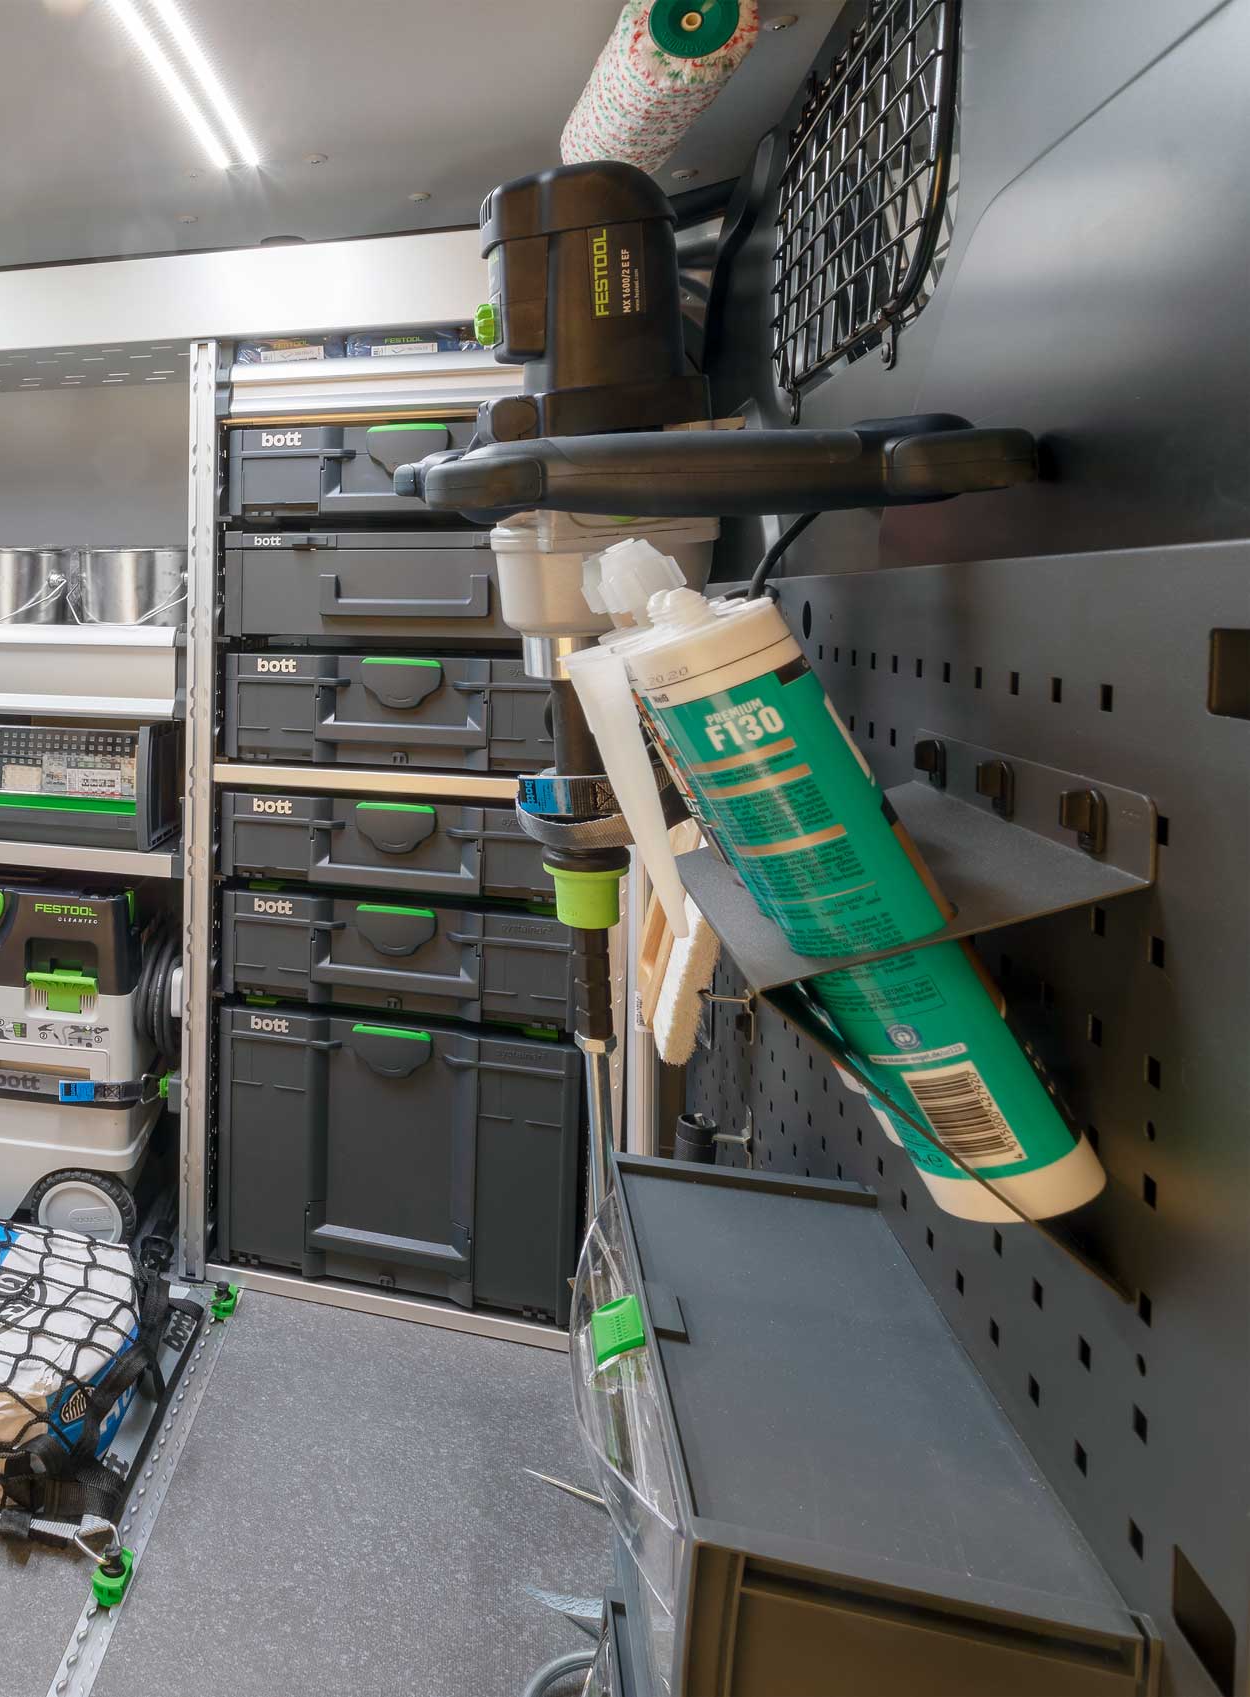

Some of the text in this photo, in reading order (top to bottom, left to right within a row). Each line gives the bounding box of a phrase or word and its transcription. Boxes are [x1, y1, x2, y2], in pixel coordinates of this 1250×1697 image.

[621, 249, 630, 260] EF
[593, 229, 609, 317] FESTOOL
[621, 268, 630, 299] 1600/2
[622, 300, 631, 313] MX
[384, 335, 423, 344] FESTOOL
[261, 432, 302, 447] bott
[254, 536, 282, 546] bott
[257, 658, 297, 673] bott
[704, 697, 765, 726] PREMIUM
[705, 706, 785, 751] F130
[253, 798, 293, 815] bott
[34, 903, 98, 917] FESTOOL
[253, 898, 293, 915] bott
[57, 916, 99, 925] CLEANTEC
[251, 1016, 289, 1033] bott
